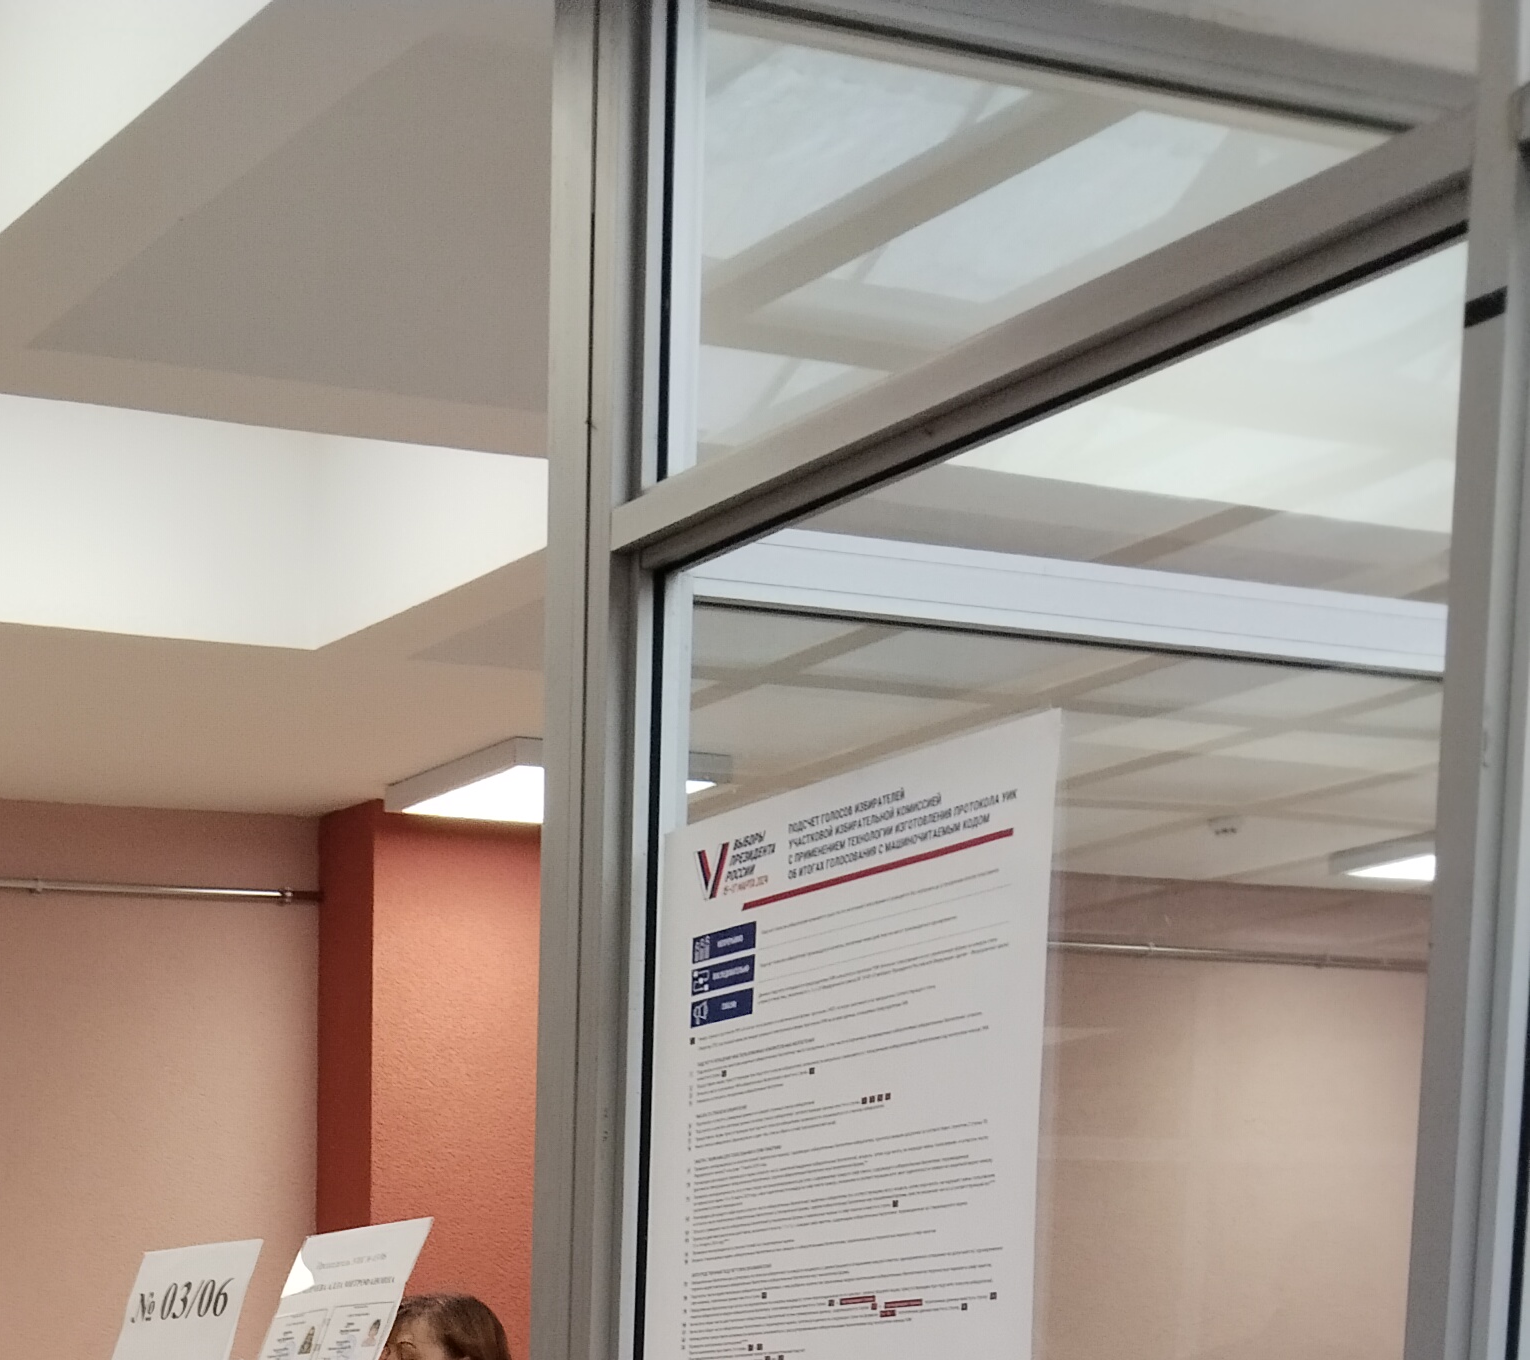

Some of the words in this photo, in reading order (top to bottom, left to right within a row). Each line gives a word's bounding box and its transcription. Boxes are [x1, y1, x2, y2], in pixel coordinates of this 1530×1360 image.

[788, 825, 833, 849] УЧАСТКОВОЙ
[896, 792, 942, 817] КОМИССИЕЙ
[820, 806, 853, 825] ГОЛОСОВ
[854, 787, 905, 813] ИЗБИРАТЕЛЕЙ
[733, 830, 766, 850] ВЫБОРЫ
[794, 839, 846, 863] ПРИМЕНЕНИЕМ
[847, 826, 894, 849] ТЕХНОЛОГИИ
[953, 795, 1000, 820] ПРОТОКОЛА
[725, 864, 756, 882] РОССИИ
[798, 861, 824, 878] ИТОГАХ
[825, 846, 878, 871] ГОЛОСОВАНИЯ
[130, 1292, 155, 1323] №
[160, 1277, 235, 1320] 03/06
